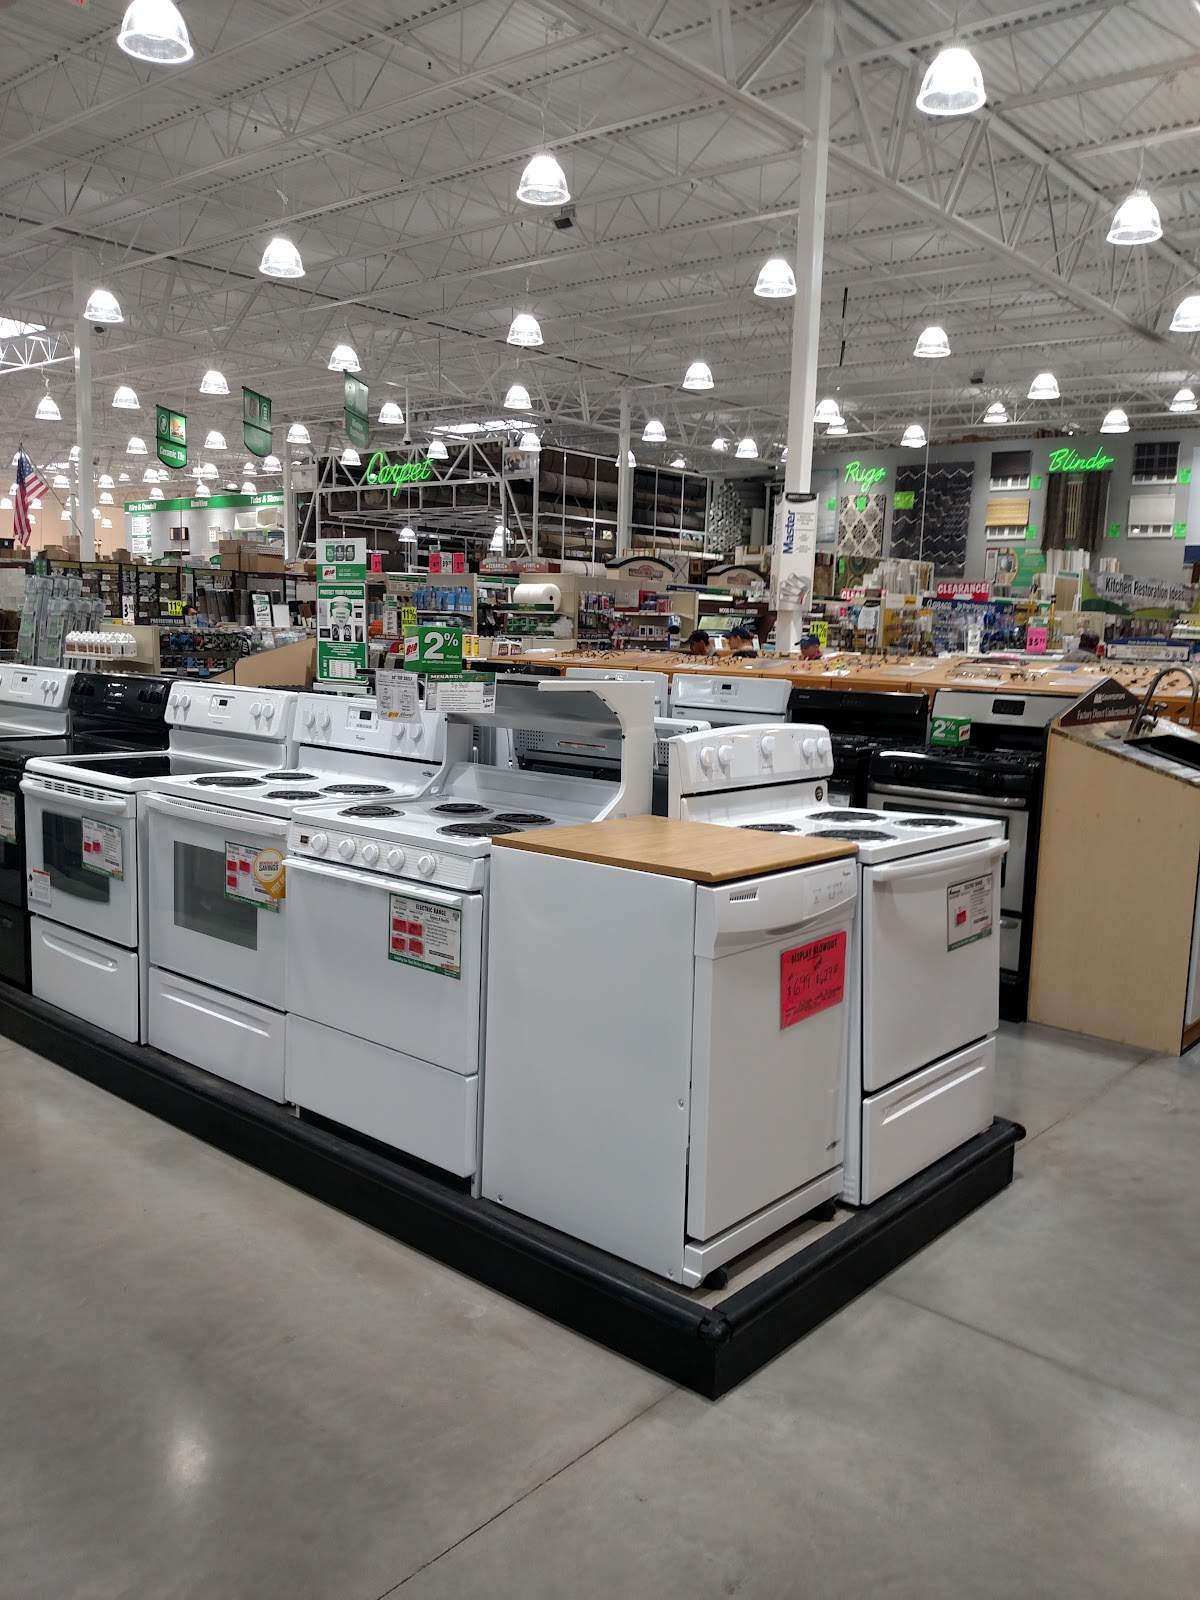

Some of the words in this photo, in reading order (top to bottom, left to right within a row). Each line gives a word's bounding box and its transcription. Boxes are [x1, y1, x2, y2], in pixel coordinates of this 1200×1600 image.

[159, 446, 177, 459] Ceramic
[1048, 446, 1114, 473] Blinds
[366, 452, 434, 497] Carpet
[844, 460, 886, 493] Rugs
[262, 495, 266, 503] &
[782, 509, 796, 554] Master
[937, 583, 990, 594] CLEARANCE!
[1105, 577, 1132, 595] Kitchen
[1133, 580, 1168, 600] Restoration
[1169, 587, 1185, 601] Ideas
[402, 608, 416, 619] 11%
[424, 631, 459, 659] 2%
[933, 719, 956, 738] 2%
[258, 864, 279, 872] SAVINGS
[790, 948, 813, 965] DISPLAY
